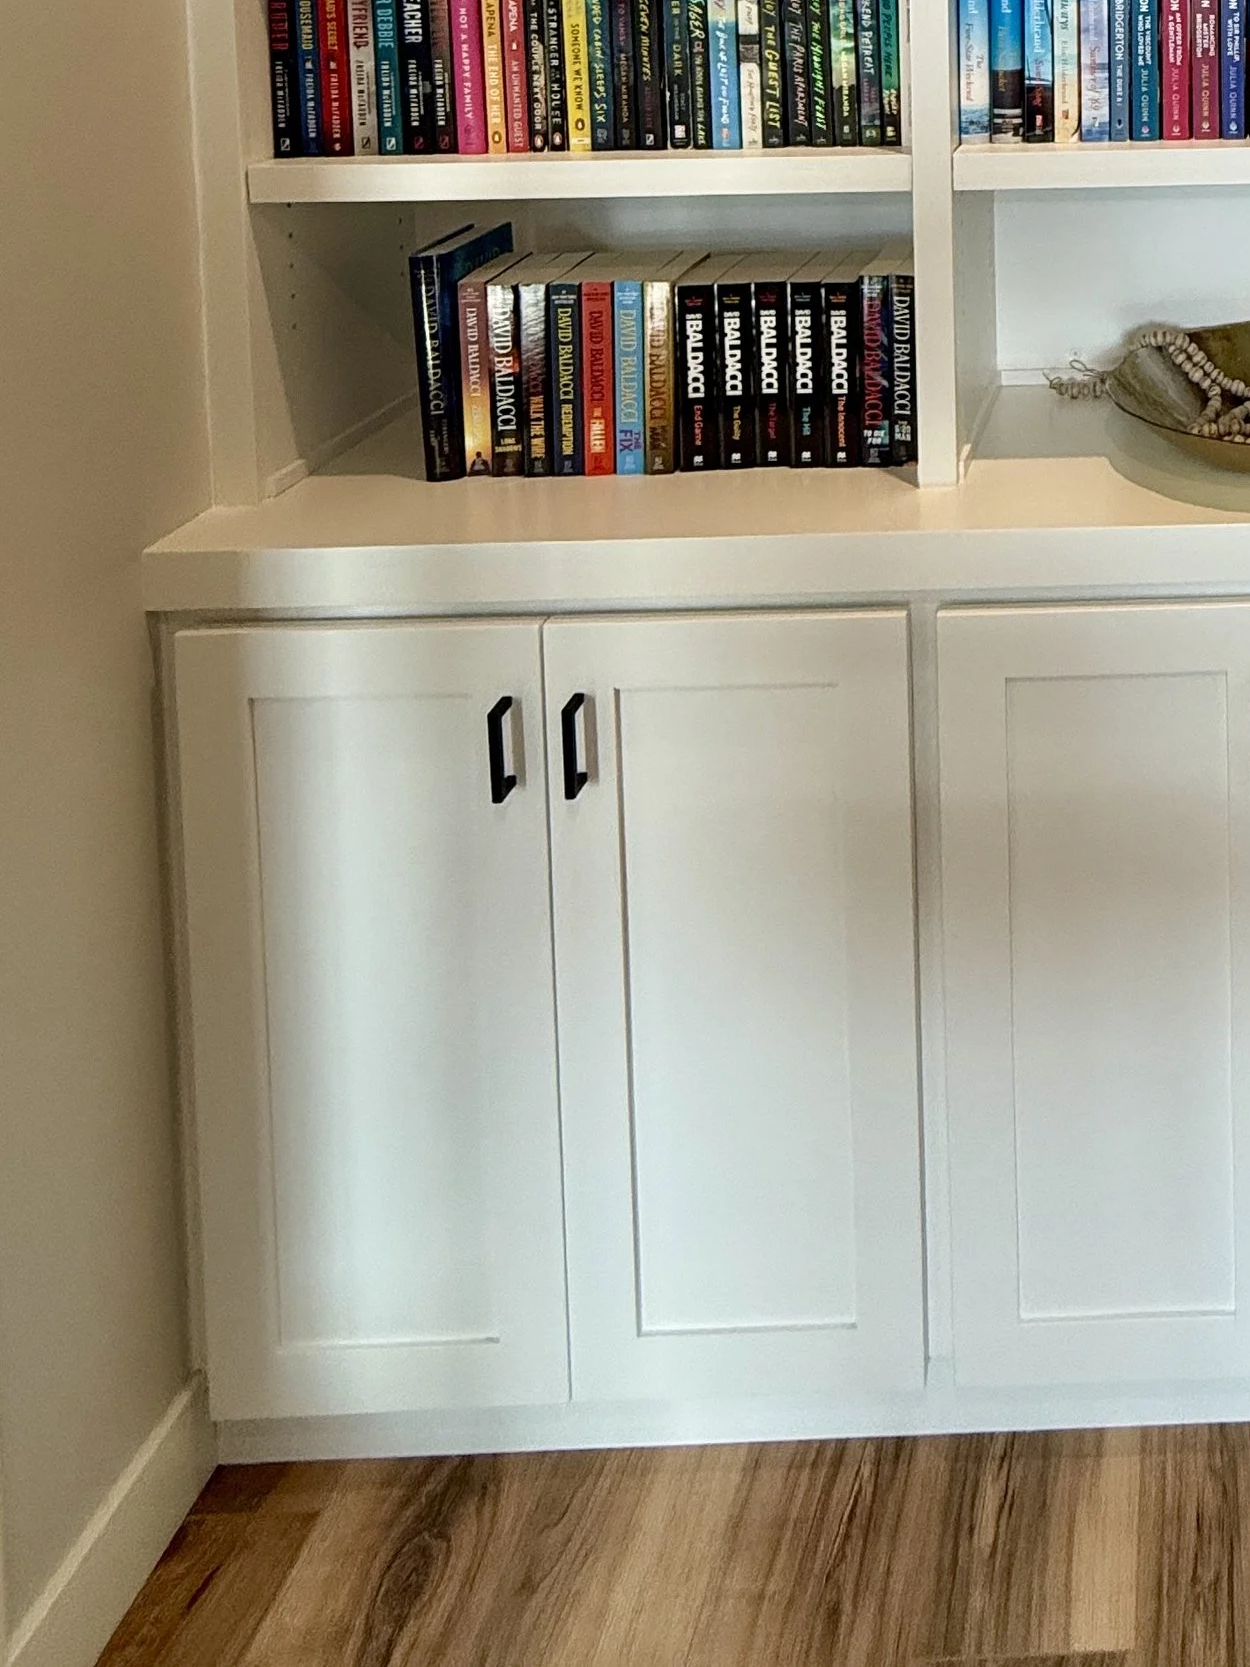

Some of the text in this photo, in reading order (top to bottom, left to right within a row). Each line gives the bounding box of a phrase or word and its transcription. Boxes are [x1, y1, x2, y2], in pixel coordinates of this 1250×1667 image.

[492, 307, 516, 431] DAVID BALDACCI
[558, 308, 573, 399] DAVID BALDACCI
[686, 320, 704, 398] BALDACCI
[562, 404, 572, 454] REDEMPTION
[620, 430, 633, 453] FIX
[694, 405, 702, 420] End
